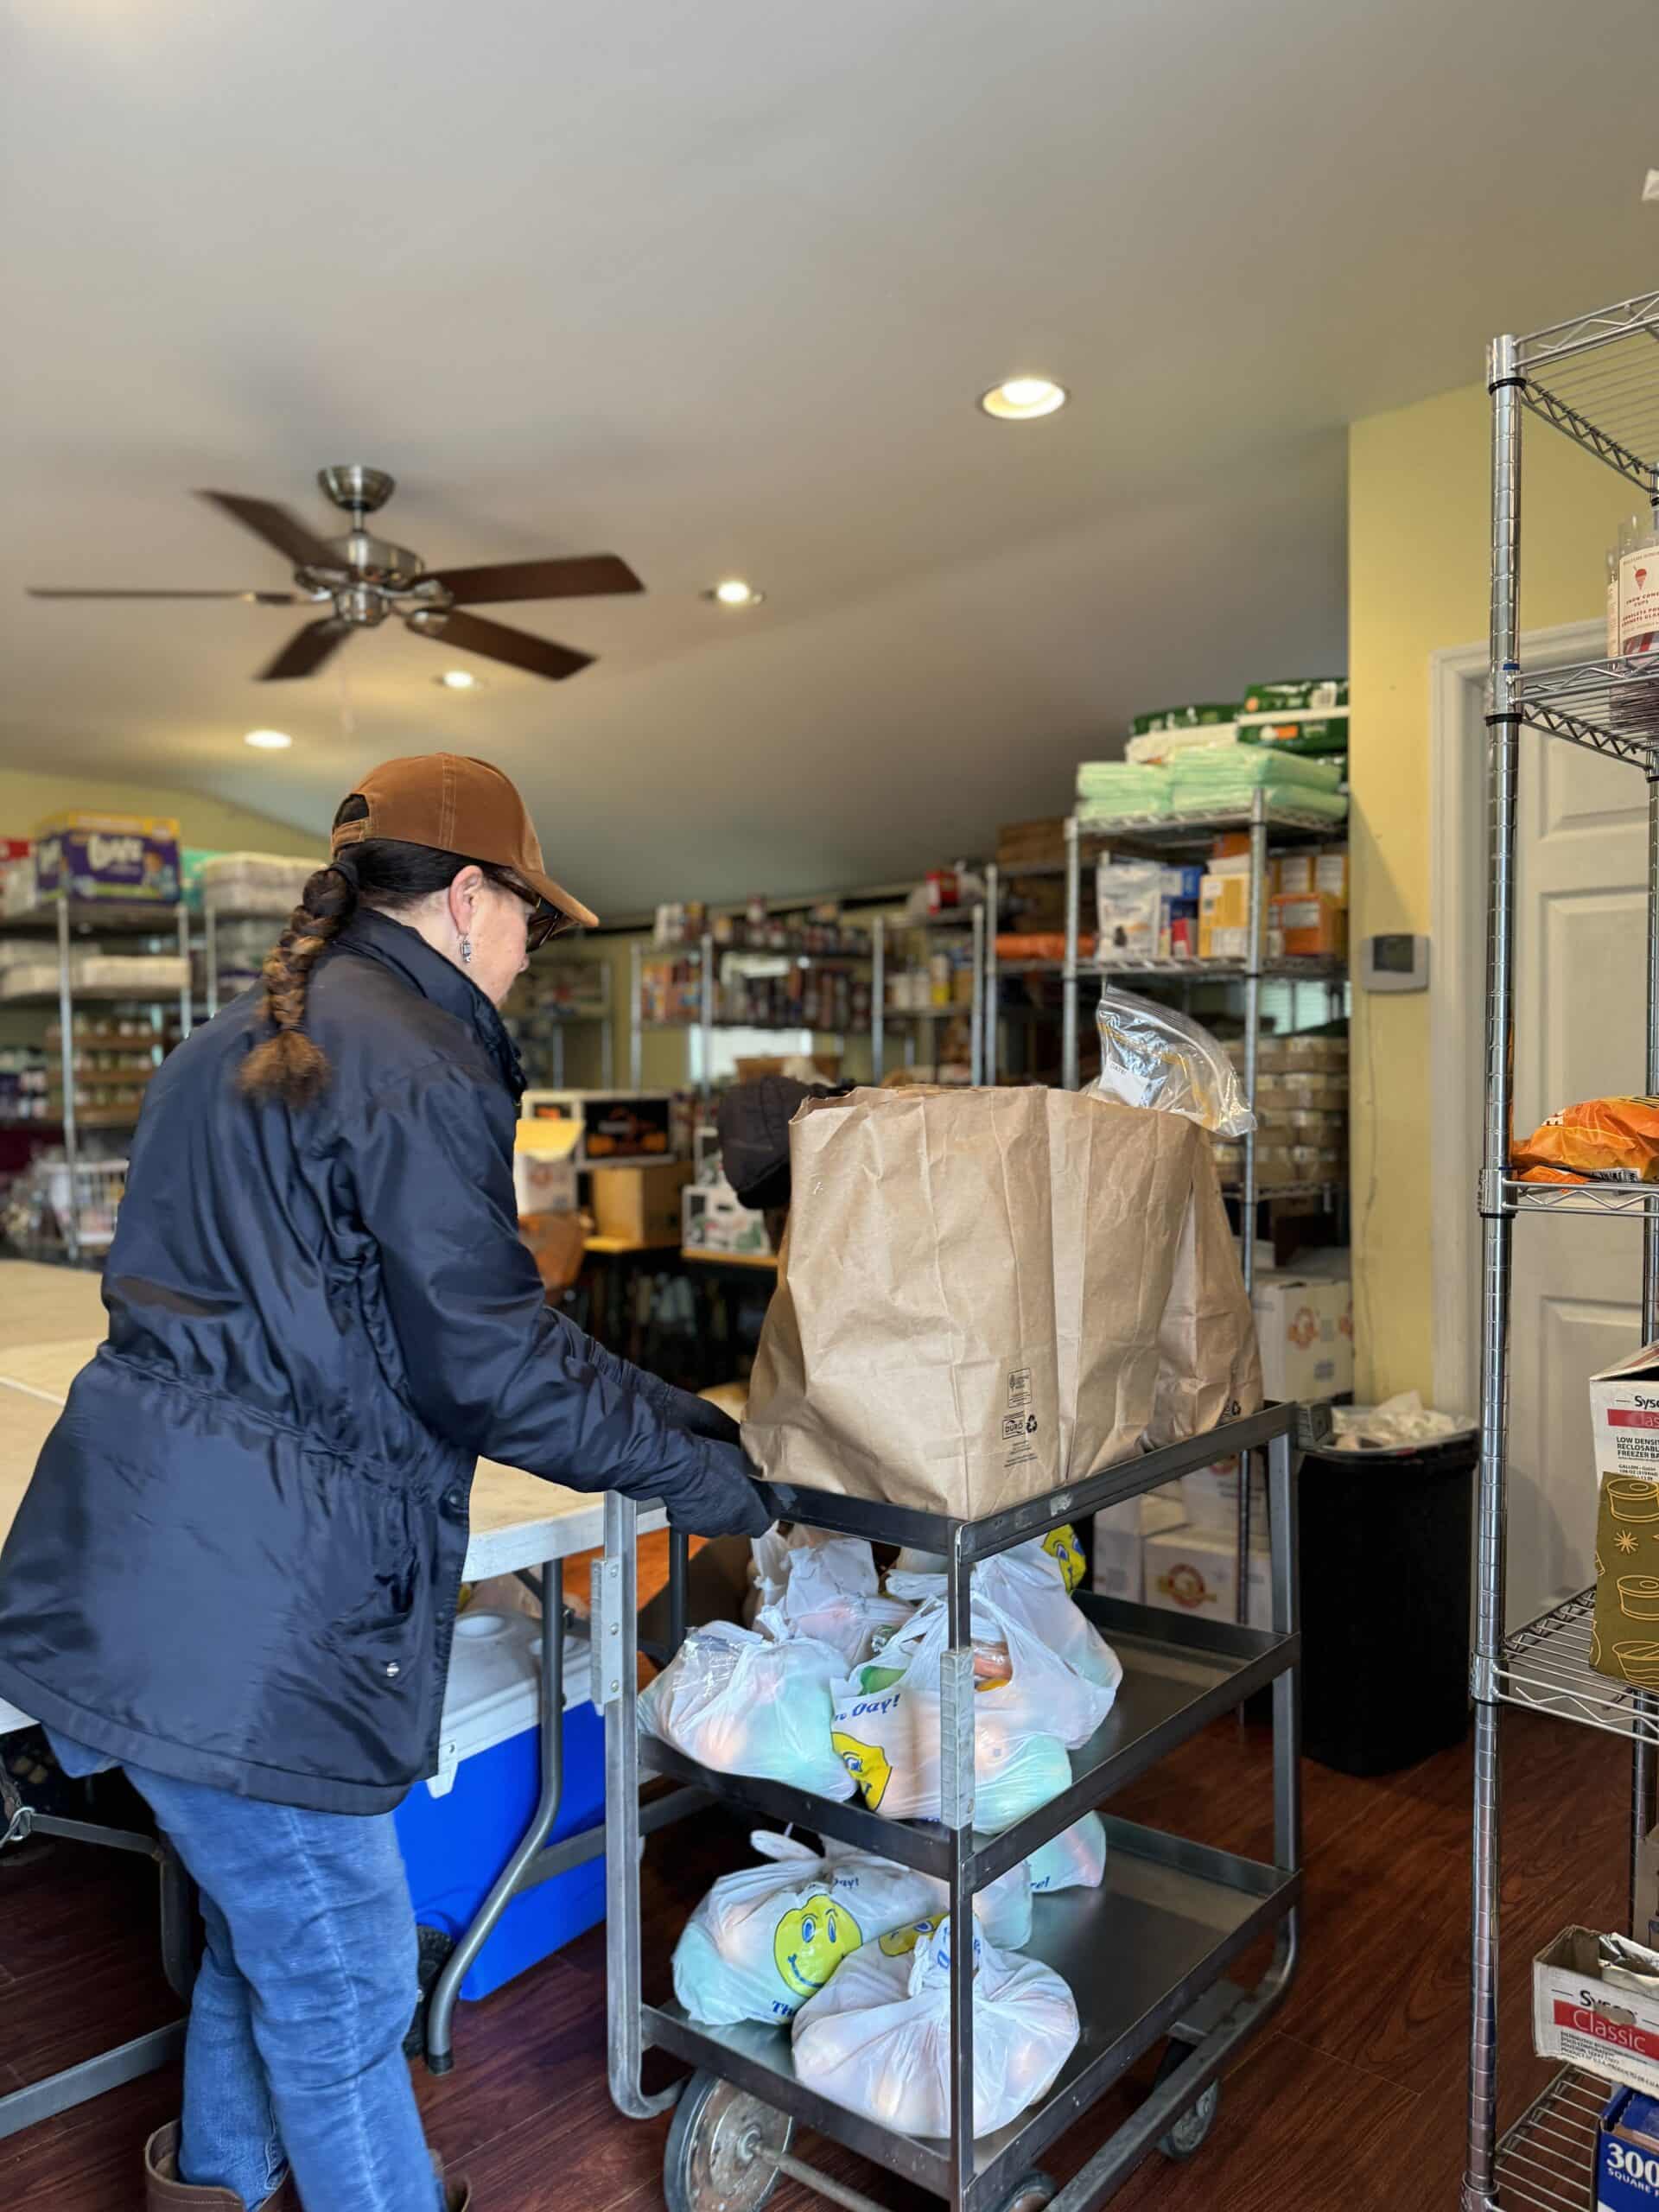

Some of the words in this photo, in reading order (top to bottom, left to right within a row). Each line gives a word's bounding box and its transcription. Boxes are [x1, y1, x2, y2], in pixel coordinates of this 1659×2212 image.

[852, 1694, 900, 1717] Day!
[1573, 2010, 1646, 2053] Classic
[1606, 2142, 1659, 2188] 300
[1607, 2167, 1651, 2194] SQUARE
